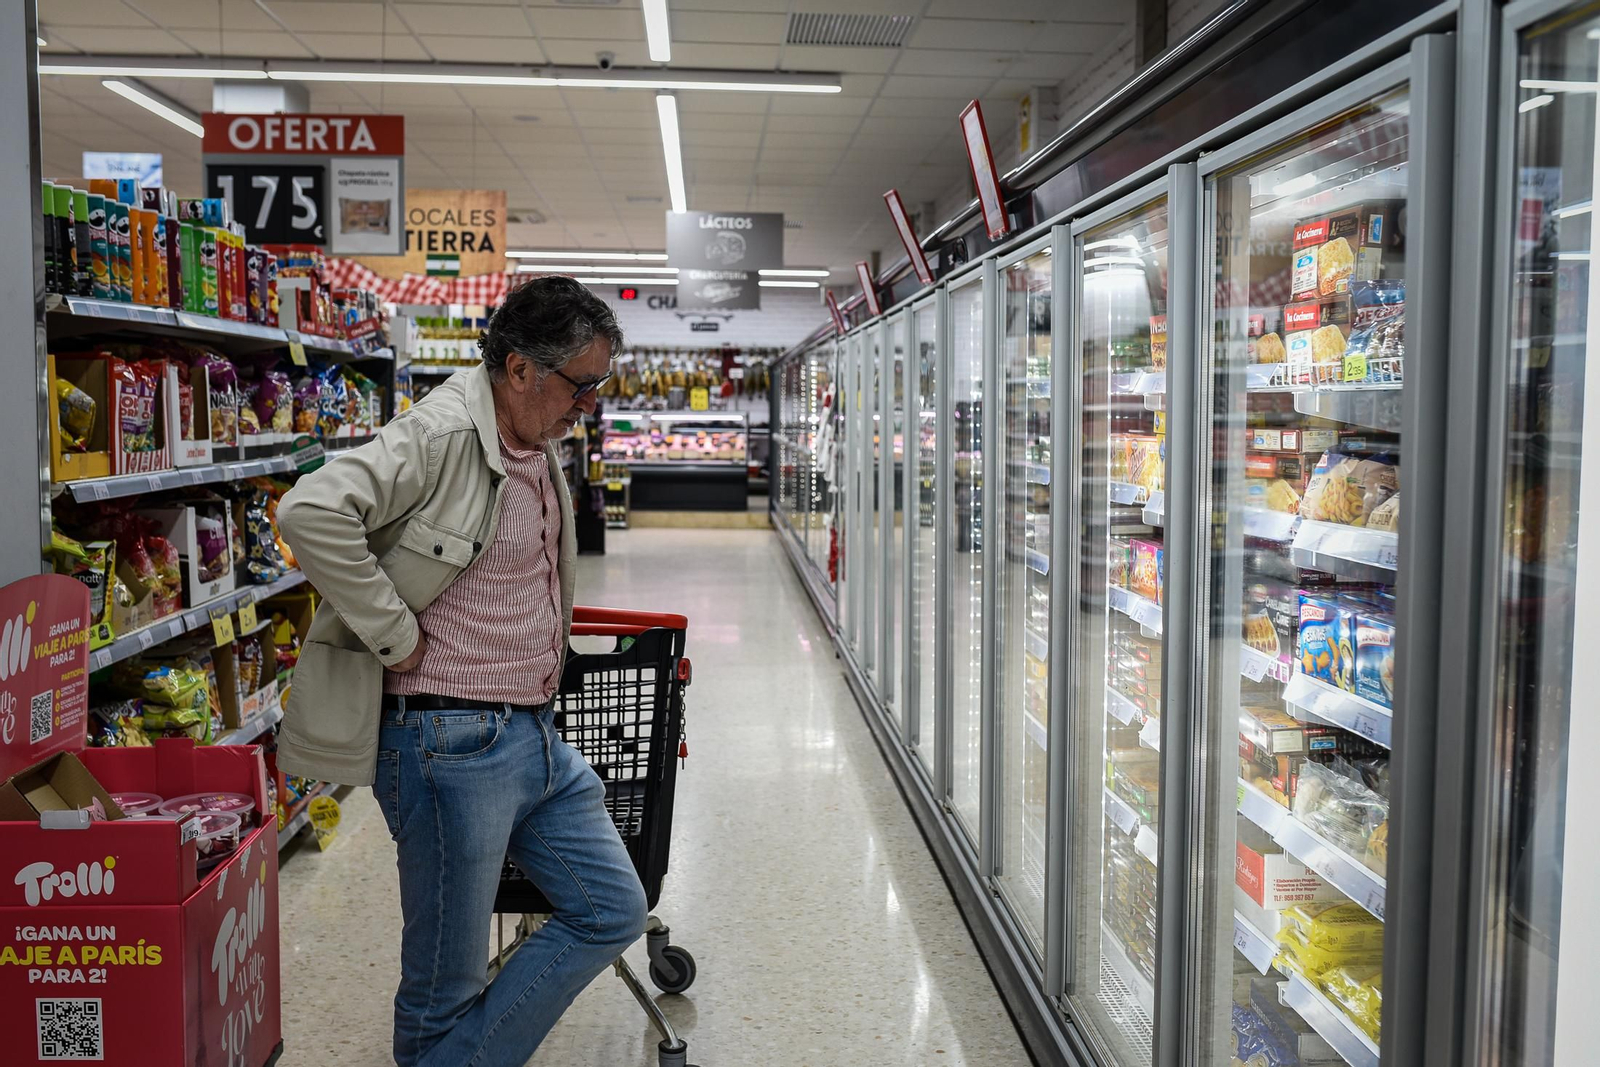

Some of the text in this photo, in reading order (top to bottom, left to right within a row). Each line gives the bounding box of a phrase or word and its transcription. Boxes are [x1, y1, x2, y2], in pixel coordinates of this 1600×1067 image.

[228, 117, 376, 150] OFERTA
[404, 207, 496, 227] OCALES
[699, 214, 753, 229] LÁCTEOS
[405, 229, 494, 252] TIERRA
[49, 617, 80, 637] ¡GANA UN
[34, 636, 60, 660] VIAJE
[60, 637, 67, 651] A
[50, 650, 76, 668] PARA 2!
[14, 855, 116, 907] Trolli
[15, 926, 116, 941] ¡GANA UN
[211, 860, 266, 1007] Trolli
[0, 938, 163, 966] AJE A PARÍS
[28, 968, 107, 984] PARA 2!
